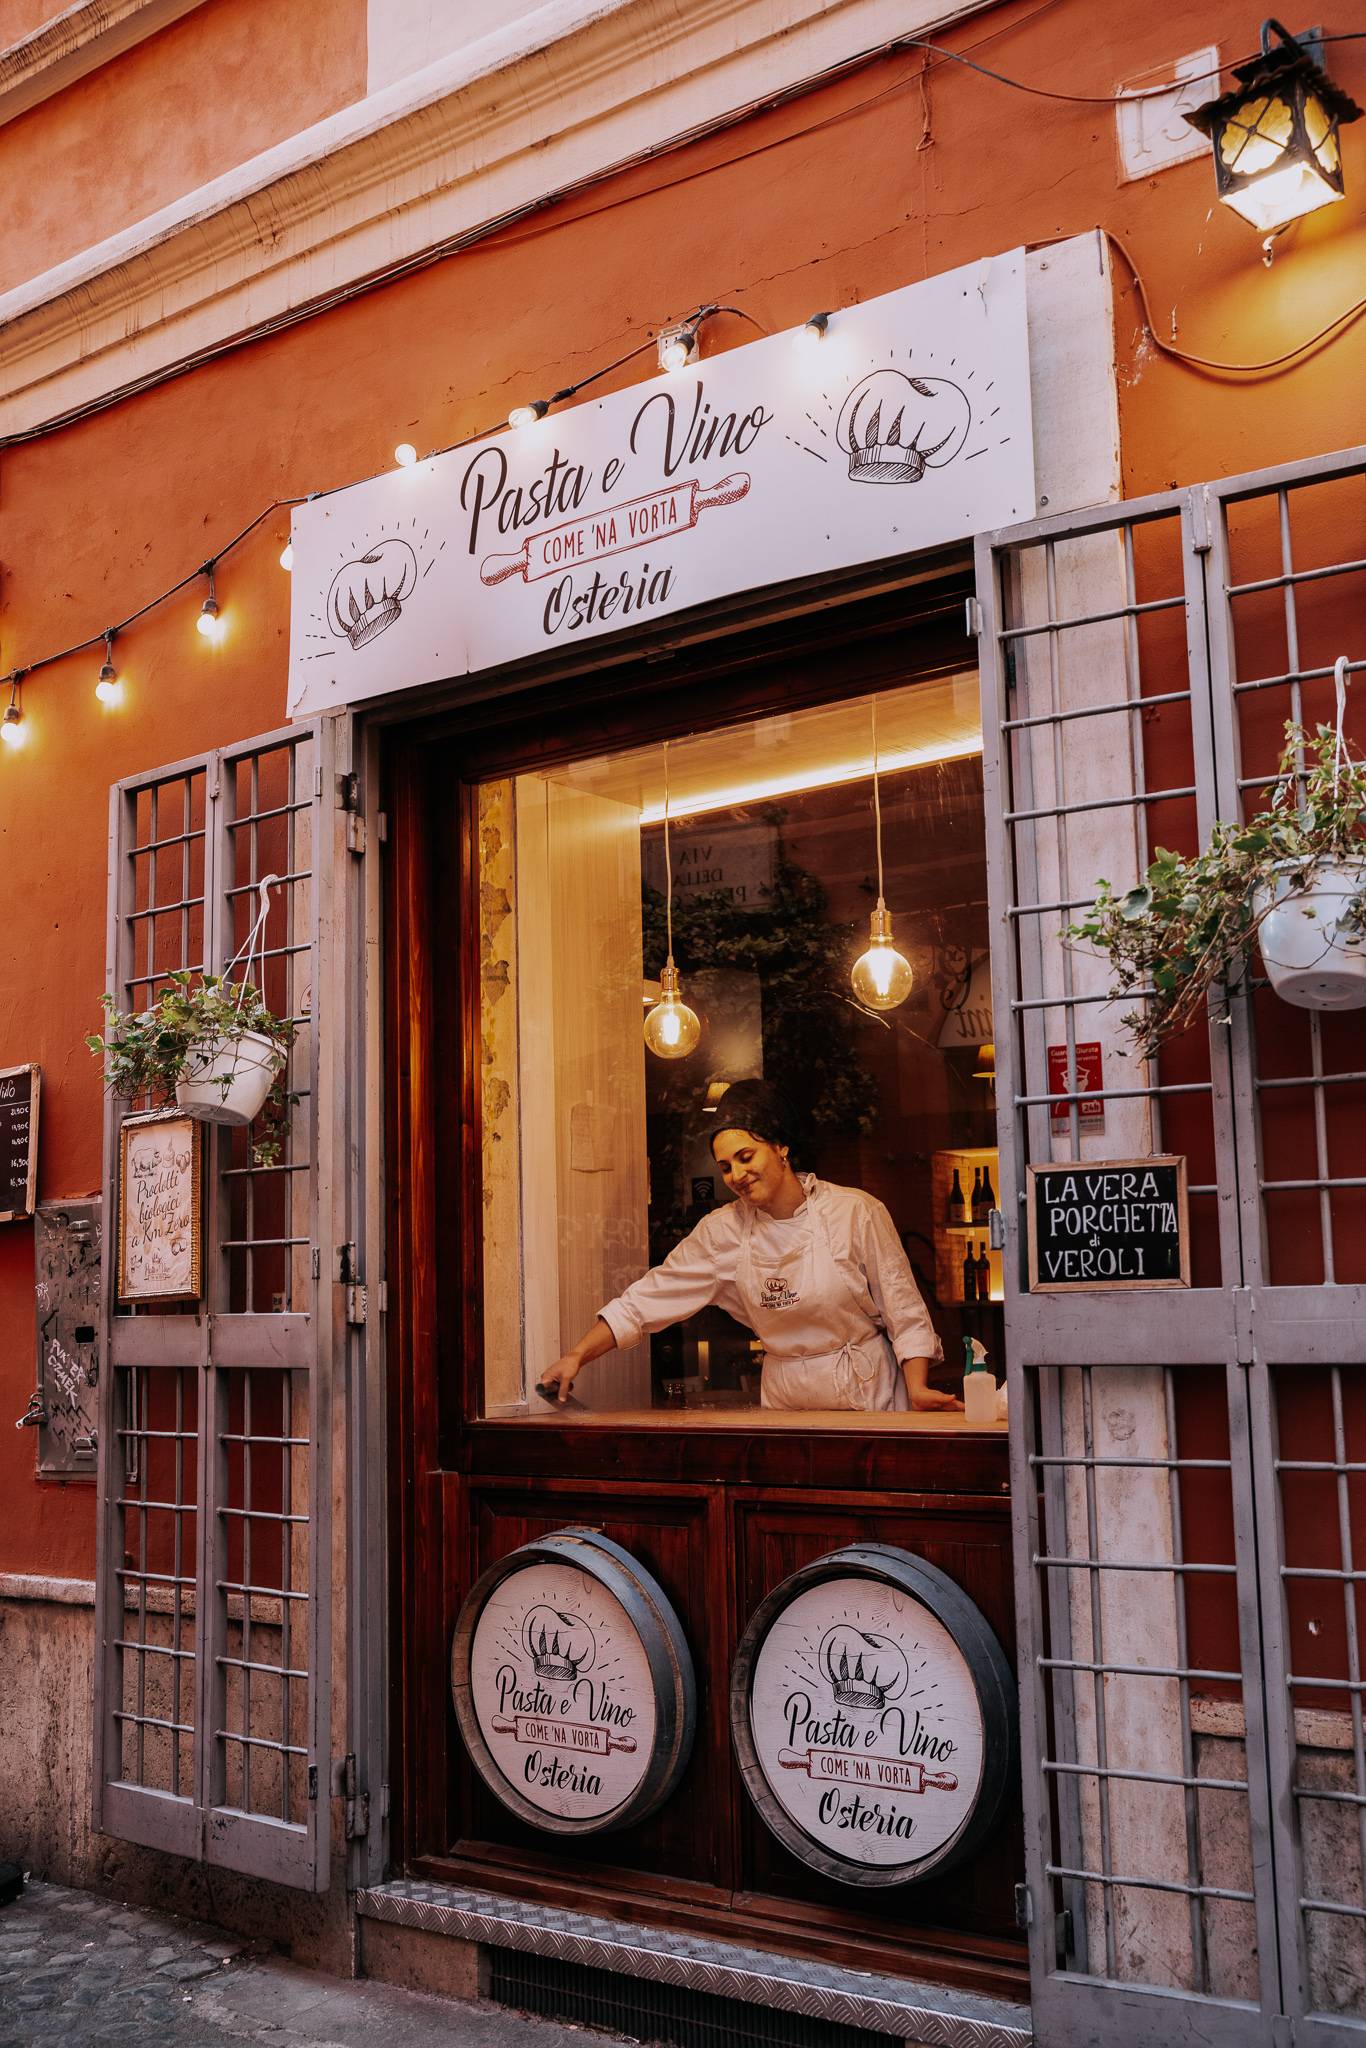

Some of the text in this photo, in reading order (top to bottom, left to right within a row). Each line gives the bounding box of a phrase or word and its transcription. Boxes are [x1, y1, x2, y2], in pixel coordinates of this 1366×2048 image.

[460, 381, 774, 554] Pasta e Vino
[543, 496, 678, 565] COME 'NA VORTA
[543, 563, 677, 635] Osteria
[137, 1170, 180, 1204] Prodotti
[1044, 1172, 1160, 1204] LA VERA
[139, 1192, 181, 1224] biologici
[1050, 1202, 1178, 1237] PORCHETTA
[131, 1235, 141, 1248] a
[1089, 1233, 1101, 1248] di
[1044, 1247, 1145, 1279] VEROLI
[496, 1665, 637, 1728] Pasta e Vino
[525, 1722, 600, 1750] COME 'NA VORTA
[783, 1691, 958, 1763] Pasta e Vino
[524, 1750, 604, 1796] Osteria
[820, 1756, 911, 1787] COME 'NA VORTA
[818, 1787, 918, 1839] Osteria
